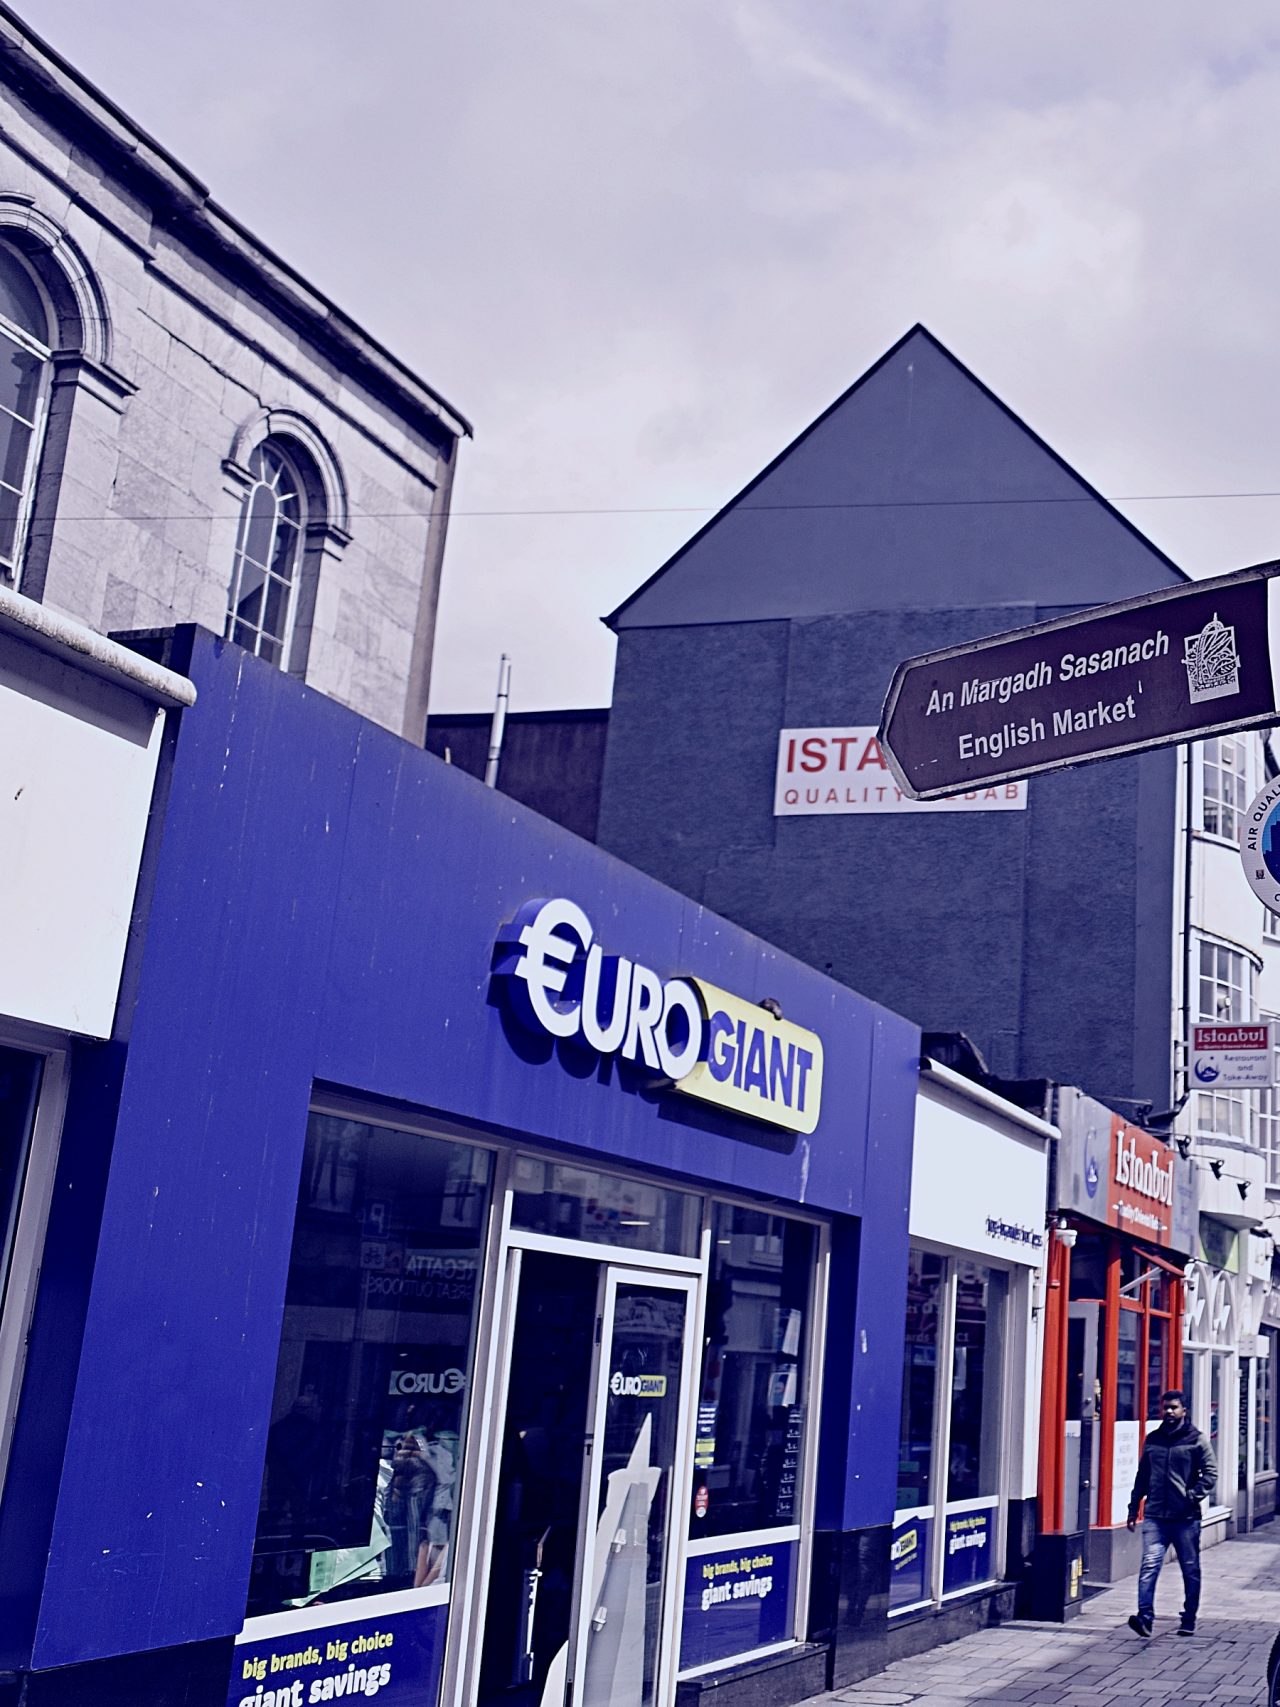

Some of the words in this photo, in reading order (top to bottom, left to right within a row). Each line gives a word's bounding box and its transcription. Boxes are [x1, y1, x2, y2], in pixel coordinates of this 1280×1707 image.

[926, 689, 954, 716] An
[960, 661, 1053, 706] Margadh
[1059, 630, 1170, 681] Sasanach
[958, 718, 1046, 759] English
[1053, 695, 1136, 736] Market
[787, 736, 889, 773] ISTA
[784, 786, 902, 804] QUALITY
[1248, 827, 1259, 851] AIR
[1197, 1028, 1264, 1043] Istanbul
[708, 1010, 813, 1113] GIANT
[1115, 1130, 1174, 1206] Istanbul
[702, 1564, 714, 1579] big
[740, 1557, 751, 1572] big
[752, 1554, 773, 1569] choice
[701, 1581, 731, 1611] giant
[732, 1574, 773, 1598] savings
[242, 1656, 268, 1680] big
[270, 1646, 323, 1674] brands,
[326, 1639, 349, 1662] big
[351, 1631, 394, 1655] choice
[308, 1662, 392, 1704] savings
